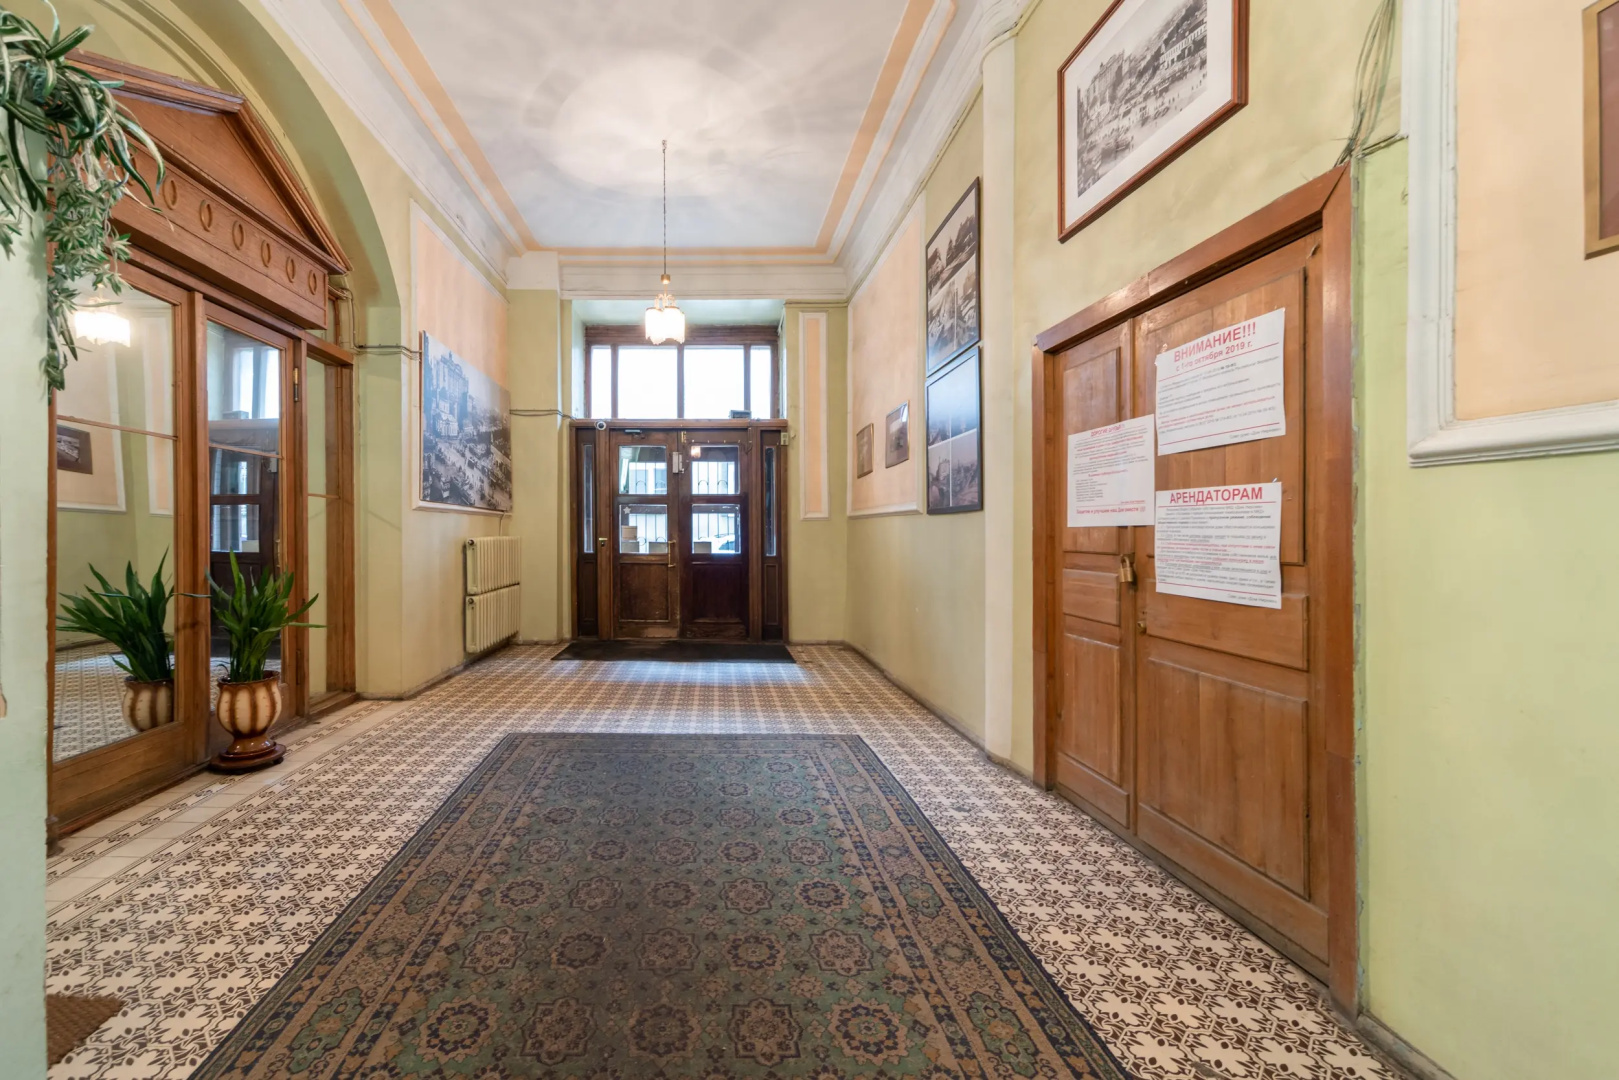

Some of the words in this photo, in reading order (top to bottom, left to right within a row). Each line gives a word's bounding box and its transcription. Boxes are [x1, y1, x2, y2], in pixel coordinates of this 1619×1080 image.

[1174, 322, 1256, 362] ВНИМАНИЕ!!!
[1195, 351, 1223, 364] октября
[1225, 342, 1245, 355] 2019
[1170, 487, 1263, 505] АРЕНДАТОРАМ
